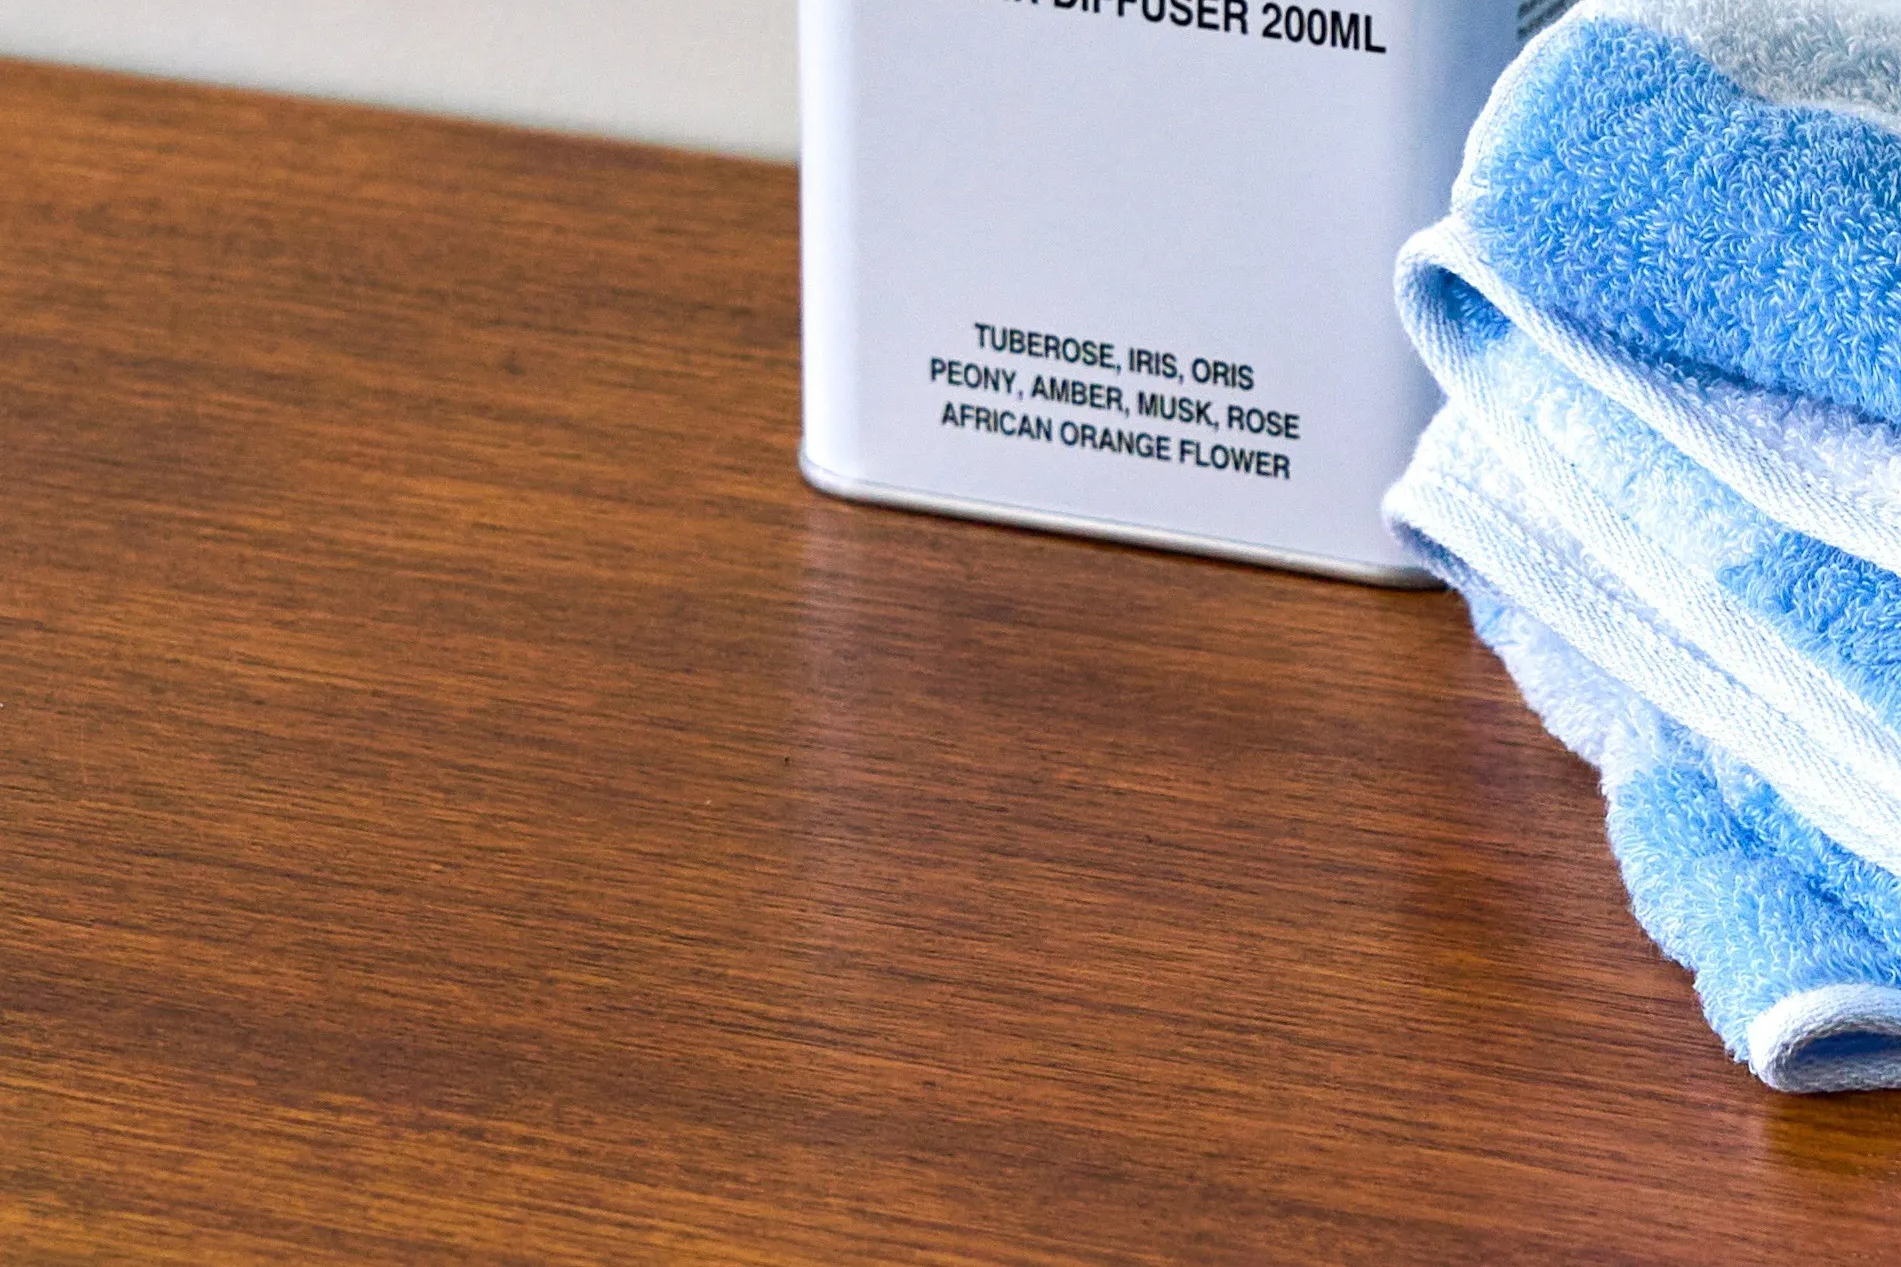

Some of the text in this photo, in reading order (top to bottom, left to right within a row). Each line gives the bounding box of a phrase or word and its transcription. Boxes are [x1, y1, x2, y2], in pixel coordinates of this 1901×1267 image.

[1262, 2, 1387, 53] 200ML
[974, 322, 1255, 391] TUBEROSE, IRIS, ORIS
[929, 357, 1300, 440] PEONY, AMBER, MUSK, ROSE
[941, 400, 1291, 480] AFRICAN ORANGE FLOWER
